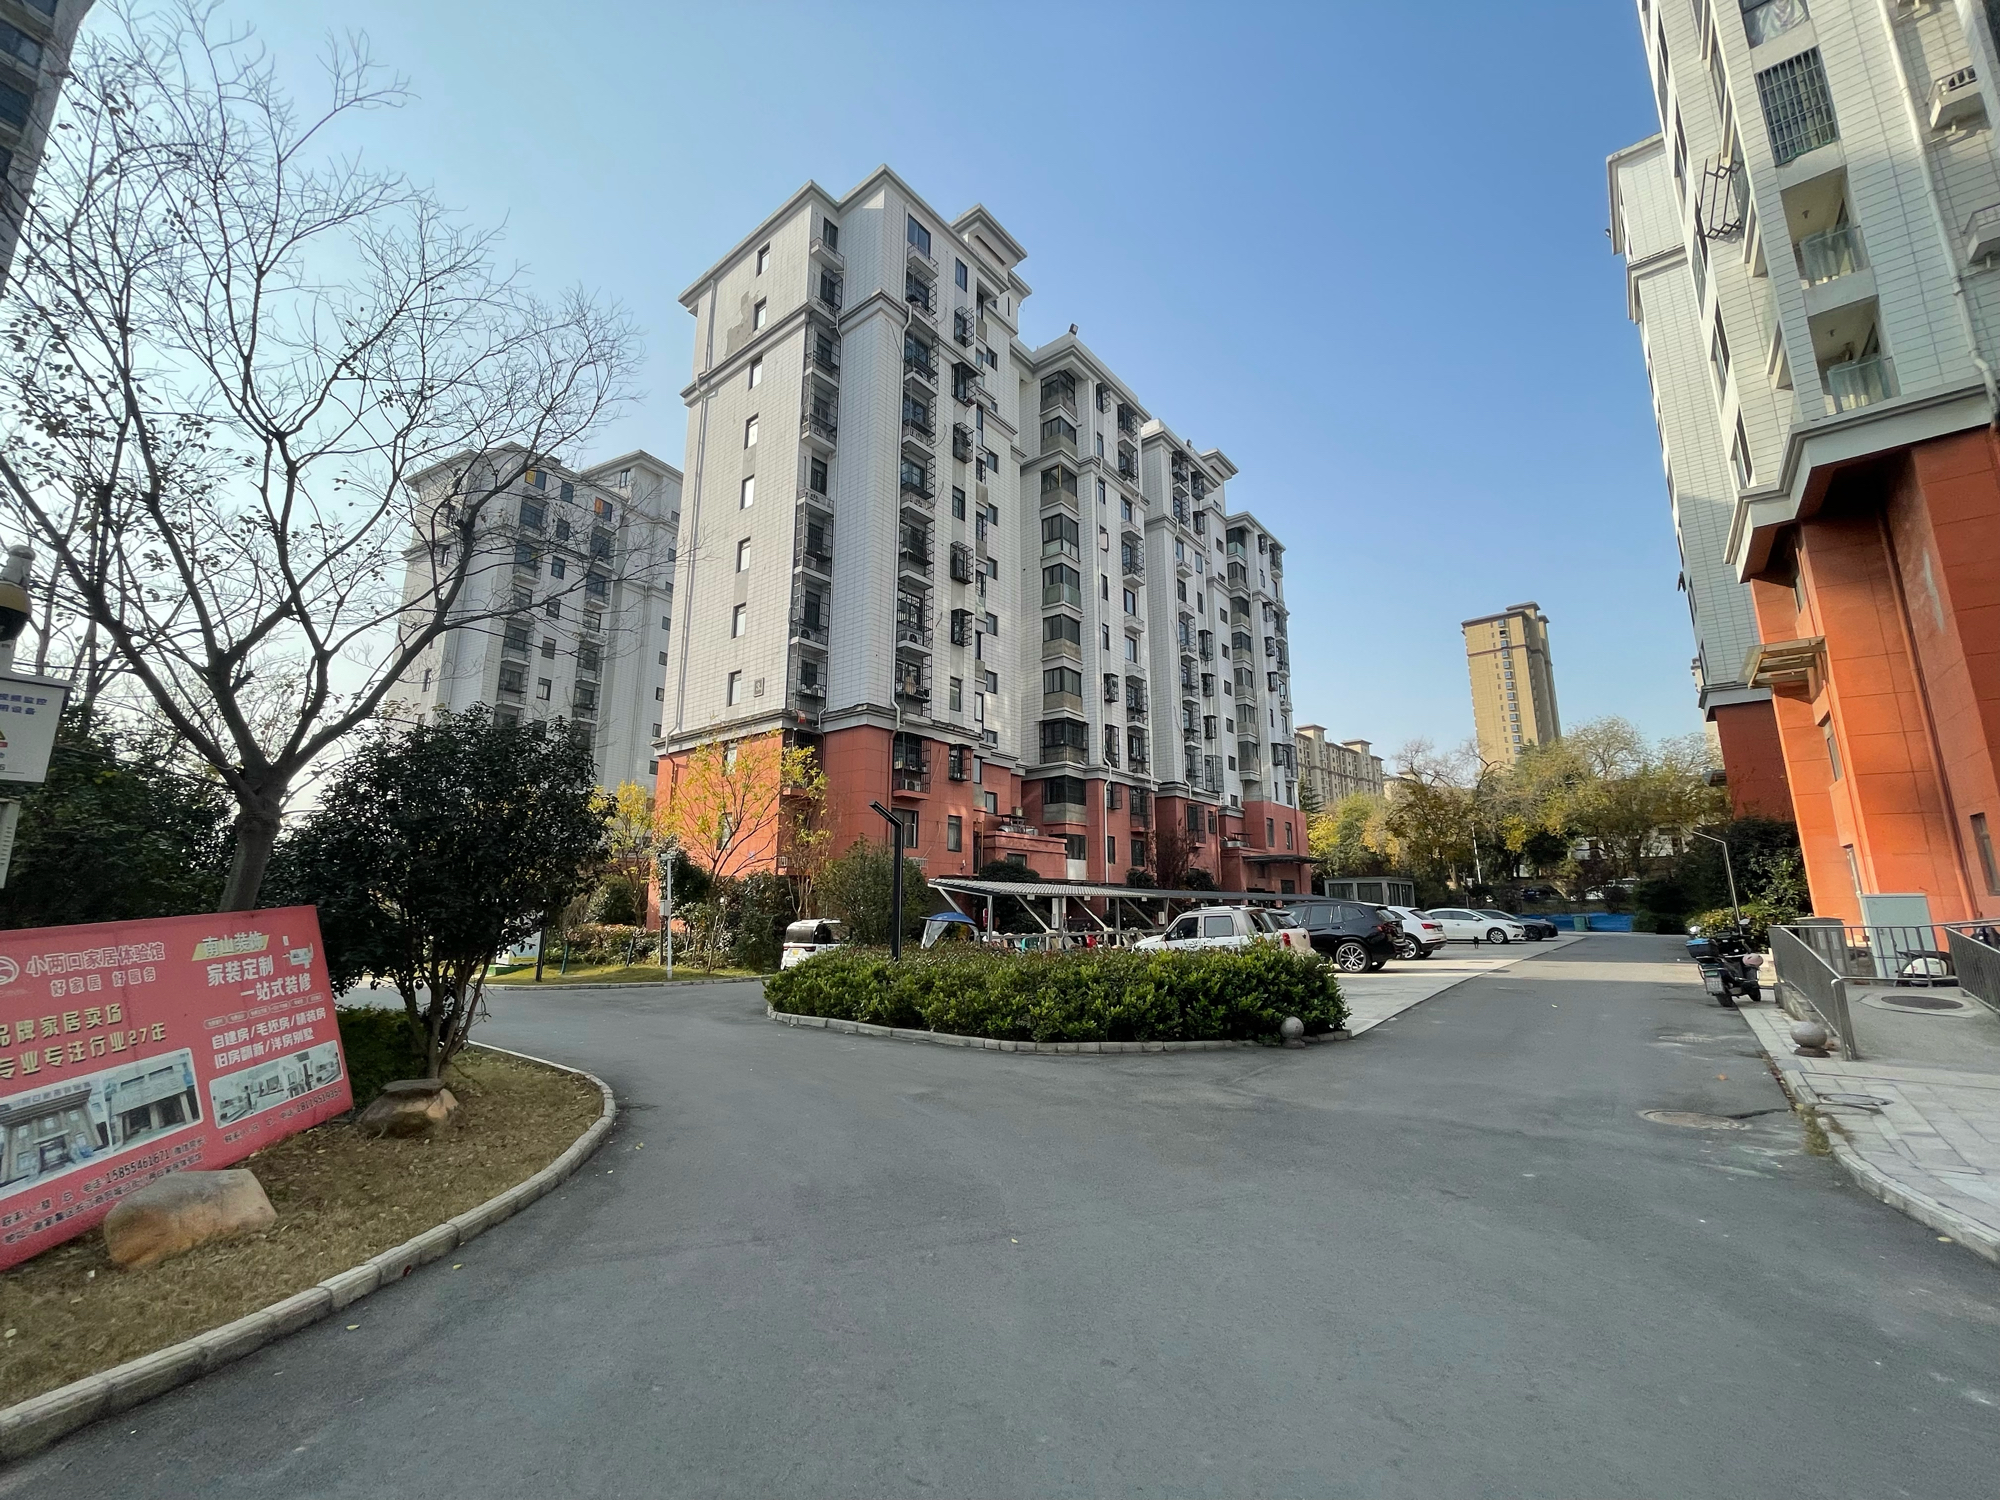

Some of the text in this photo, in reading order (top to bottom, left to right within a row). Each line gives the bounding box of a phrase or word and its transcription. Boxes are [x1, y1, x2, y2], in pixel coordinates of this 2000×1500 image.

[26, 942, 165, 977] 小两口家居体验馆
[202, 931, 265, 957] 南山装饰
[50, 975, 101, 997] 好家居
[112, 967, 156, 988] 好服务
[206, 955, 274, 987] 家装定制
[240, 973, 312, 1001] 一站式装修
[0, 1022, 167, 1079] 专业专注行业27年
